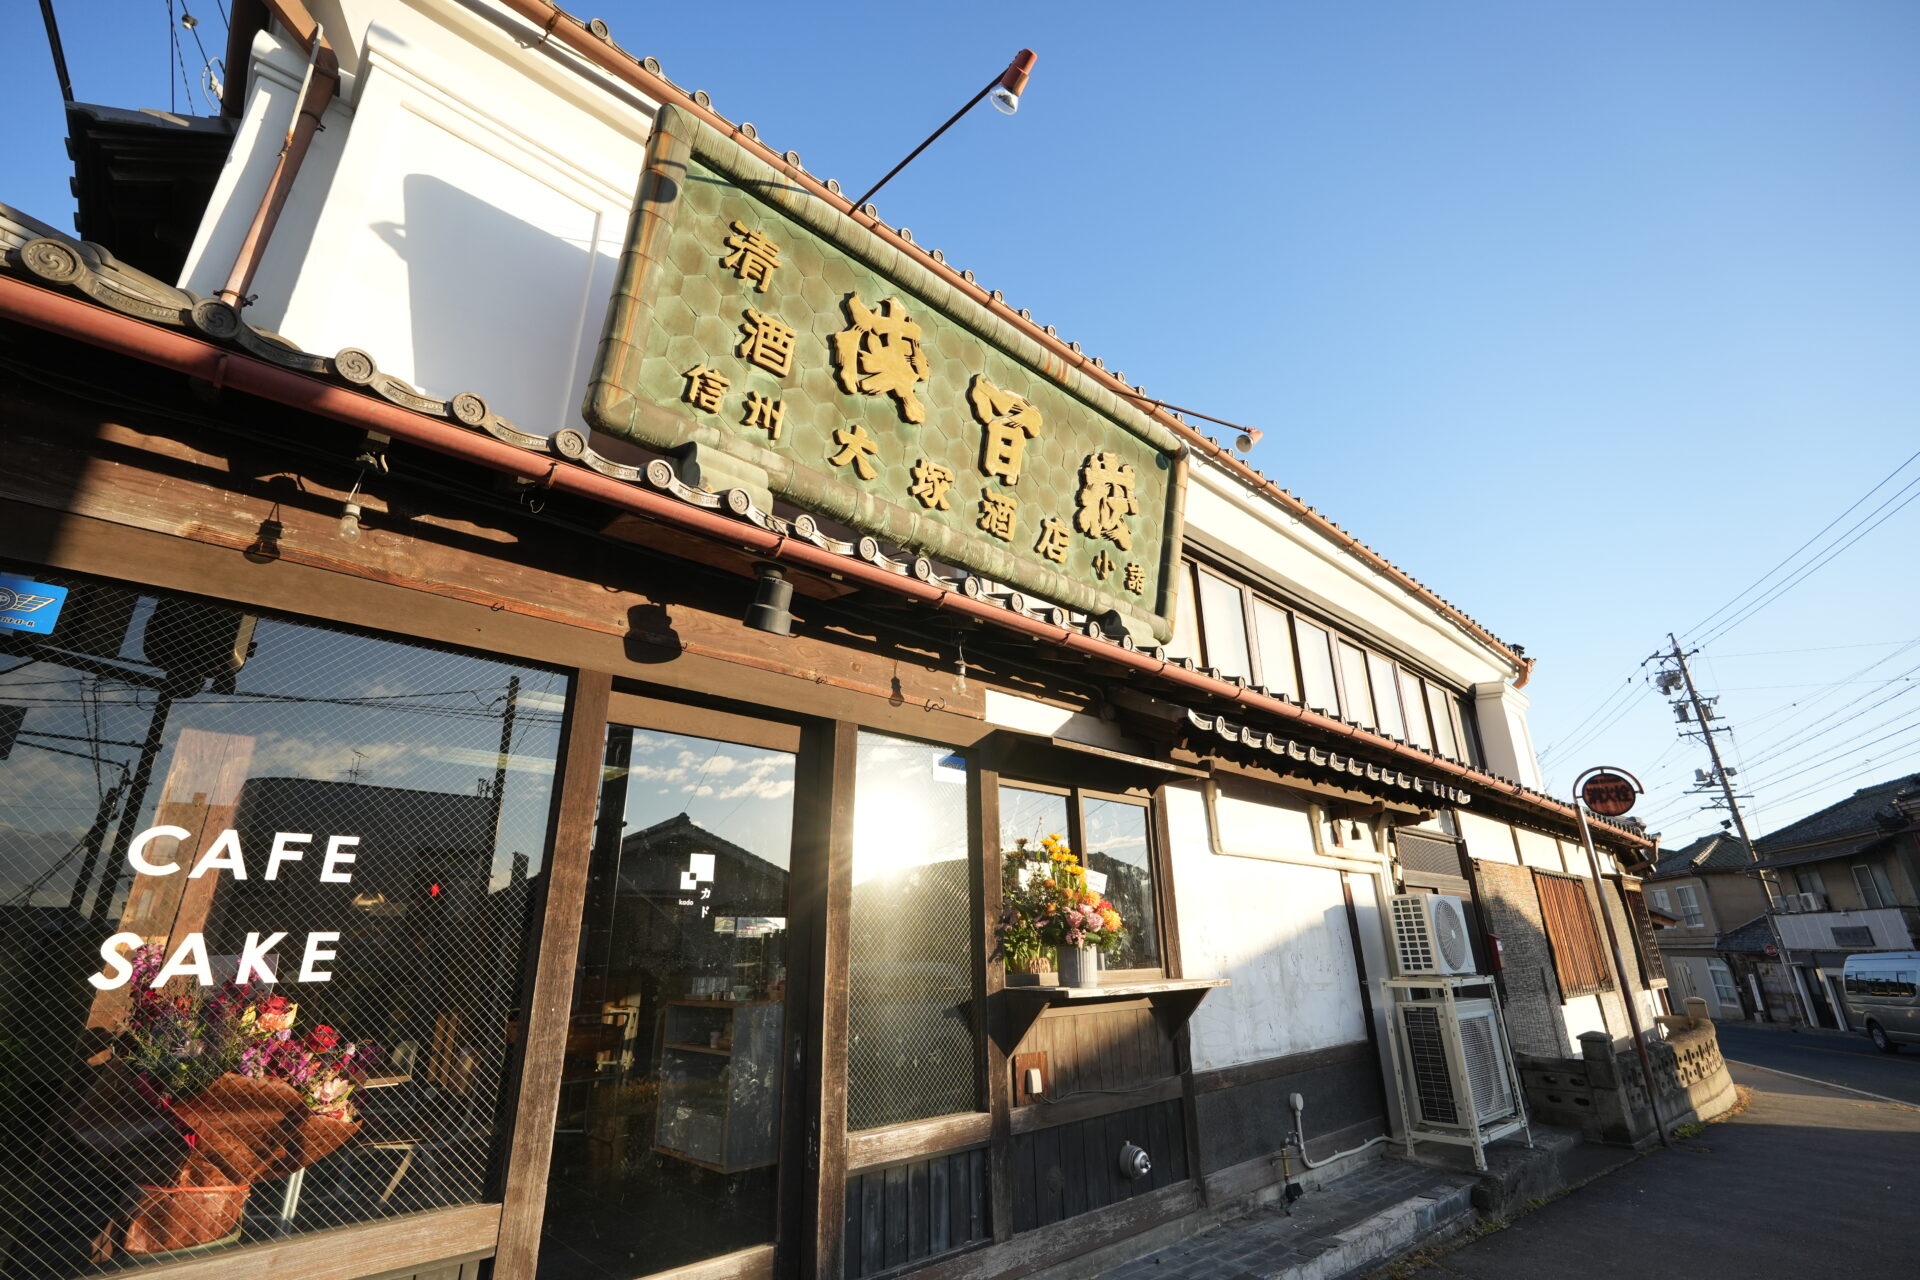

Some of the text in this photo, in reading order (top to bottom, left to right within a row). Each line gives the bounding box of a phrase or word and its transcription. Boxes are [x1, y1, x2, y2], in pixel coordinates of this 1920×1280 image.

[721, 220, 797, 378] 清酒
[683, 363, 787, 440] 信州
[1091, 549, 1146, 595] 小諸
[128, 825, 360, 883] CAFE
[678, 898, 694, 906] kado
[700, 887, 712, 919] カド
[87, 931, 340, 991] SAKE
